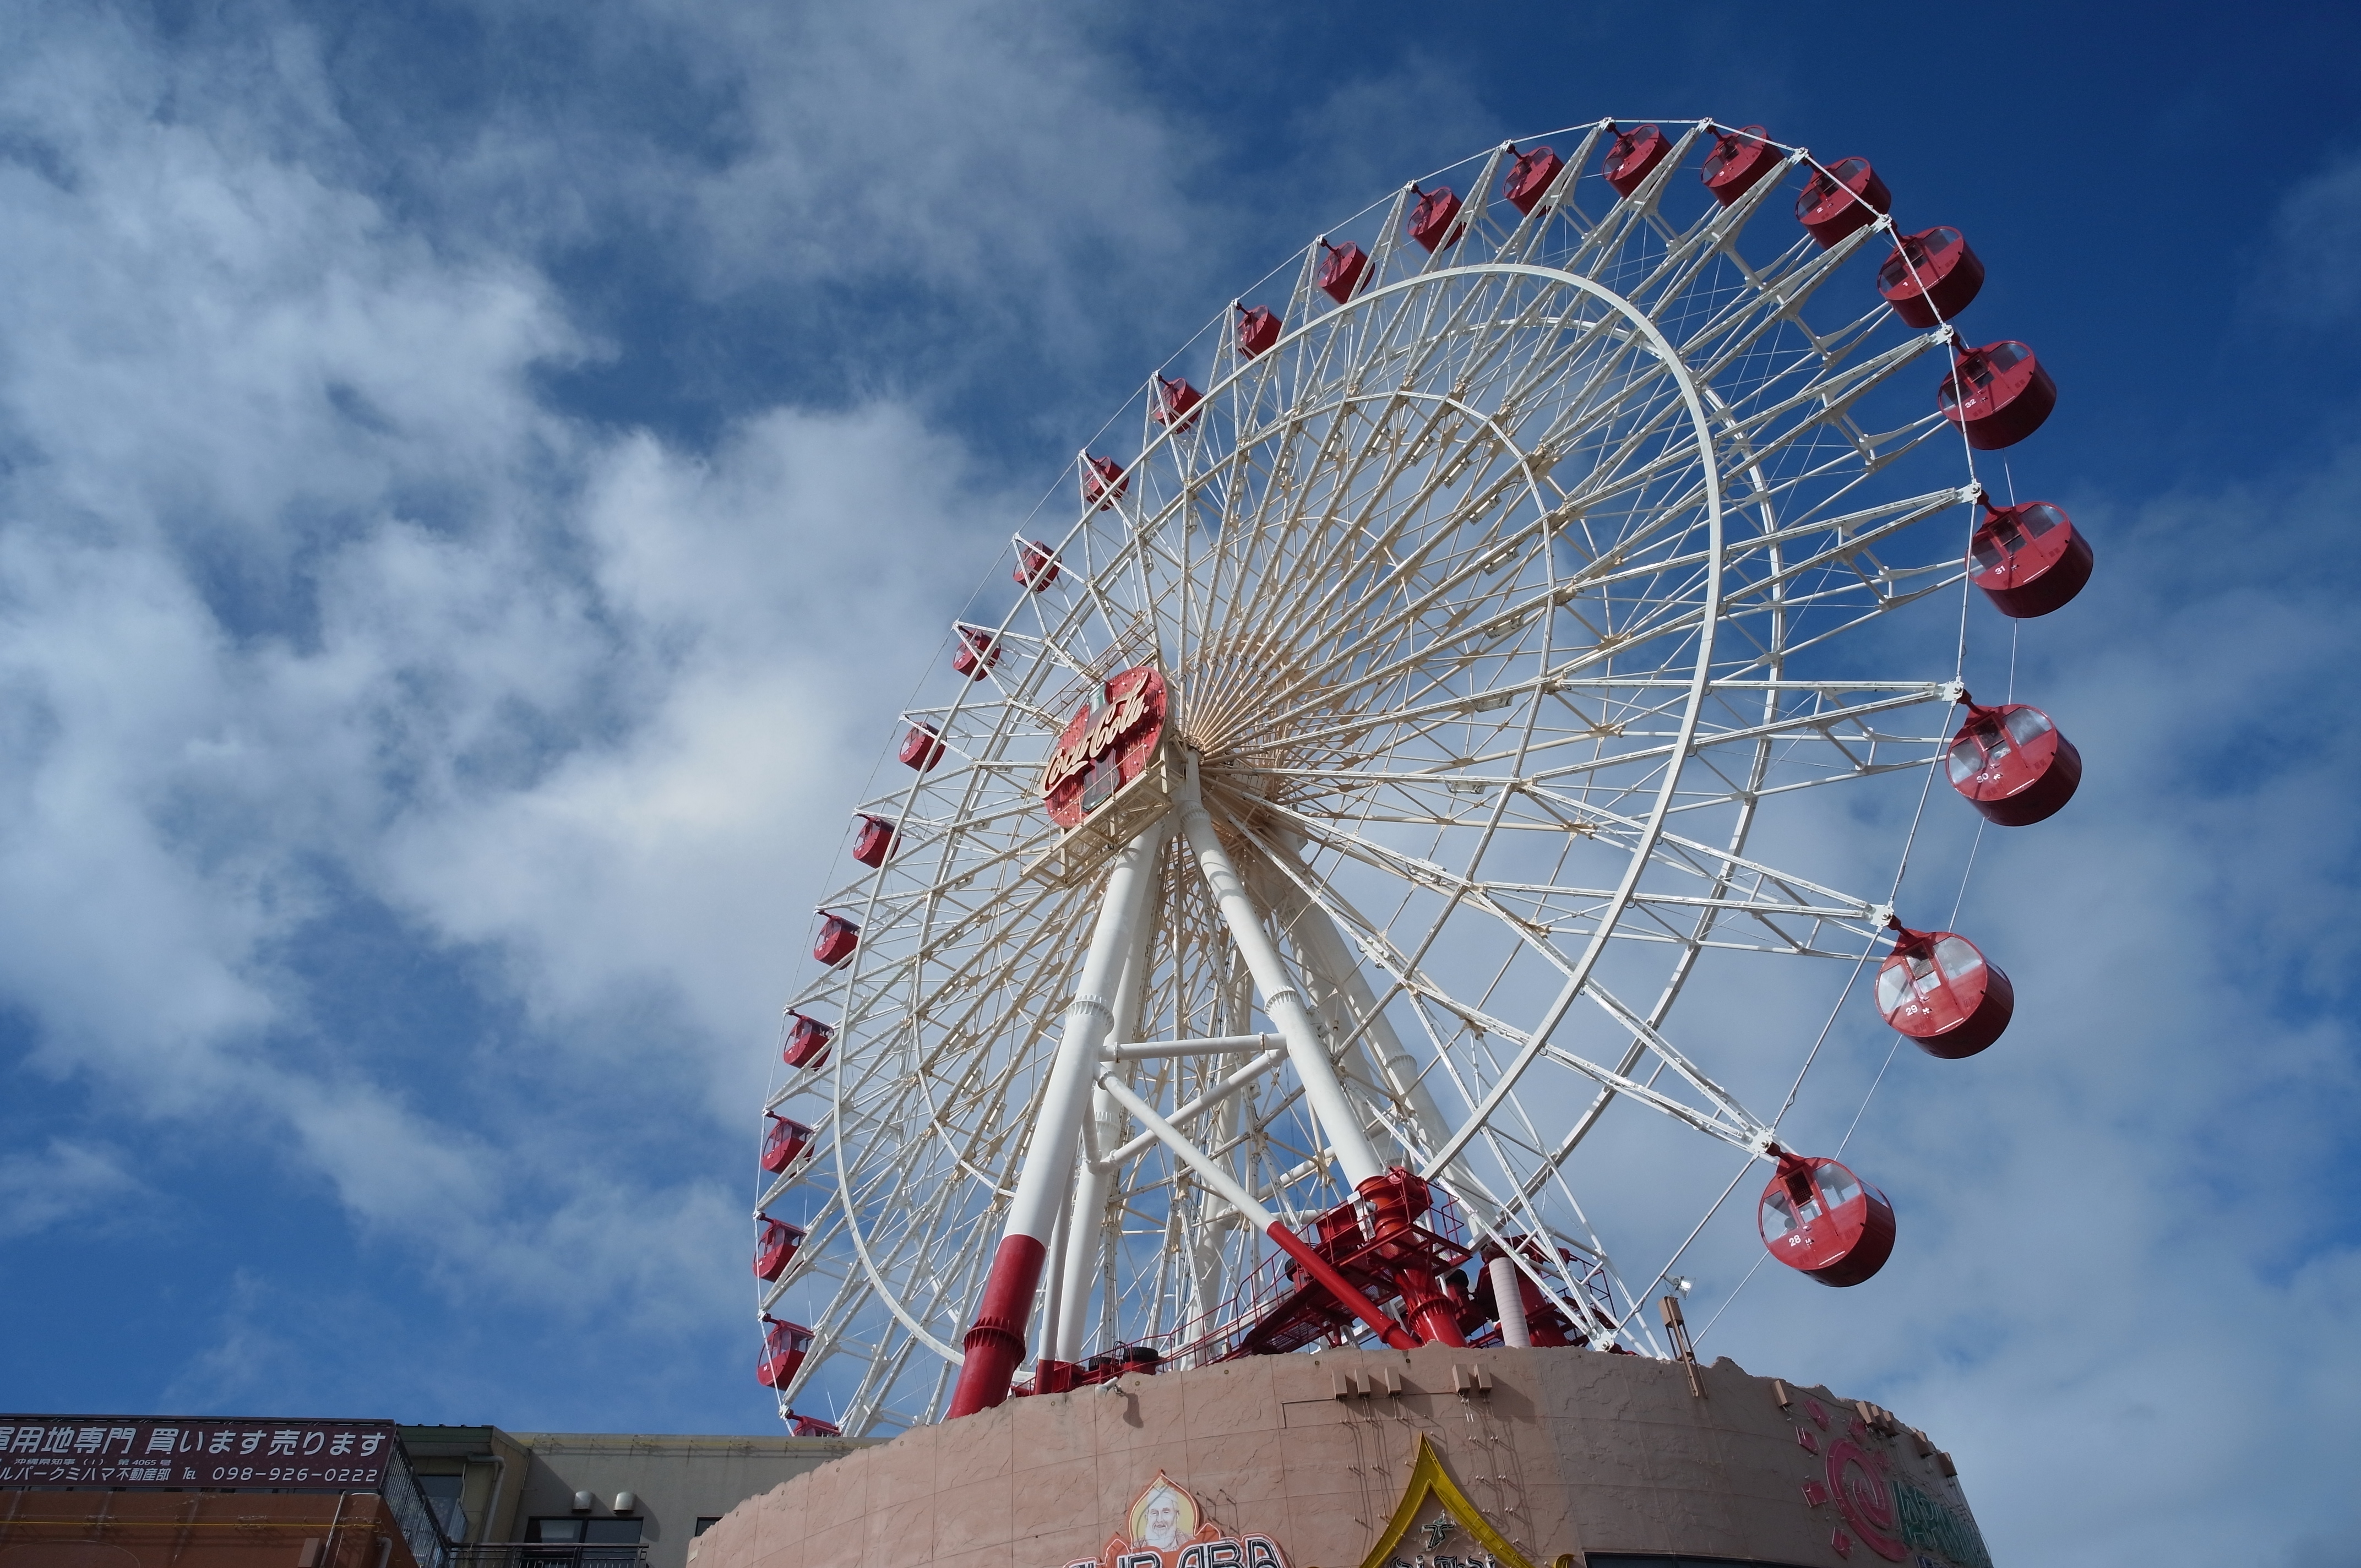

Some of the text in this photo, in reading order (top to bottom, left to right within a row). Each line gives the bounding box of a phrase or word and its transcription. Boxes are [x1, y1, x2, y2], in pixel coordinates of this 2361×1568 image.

[1965, 399, 1977, 409] 32
[1995, 565, 2006, 575] 31
[1976, 772, 1989, 783] 30
[1906, 1004, 1918, 1016] 29
[1788, 1234, 1801, 1247] 28
[145, 1428, 387, 1457] 買います売ります
[0, 1465, 172, 1482] ルパークミハマ不動産部
[212, 1467, 378, 1483] 098-926-0222
